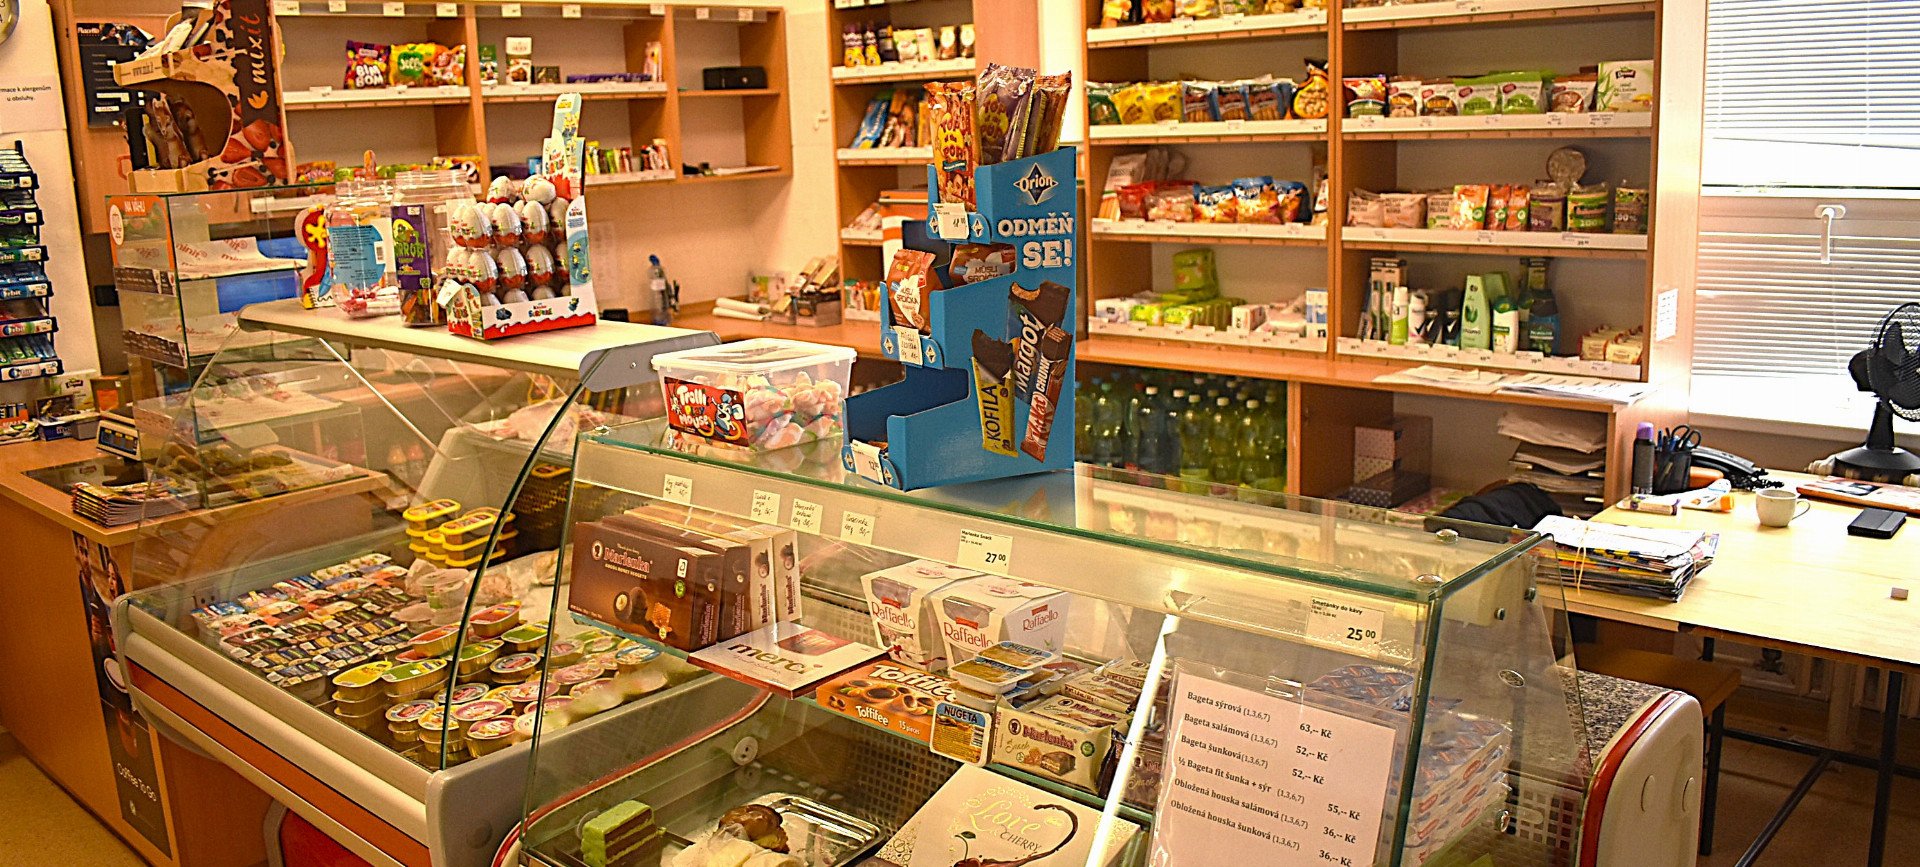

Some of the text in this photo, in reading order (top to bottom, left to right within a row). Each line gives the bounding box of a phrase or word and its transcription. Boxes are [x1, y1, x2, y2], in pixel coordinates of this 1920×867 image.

[240, 13, 267, 84] mixit
[355, 64, 381, 77] BIM
[355, 75, 384, 88] BOM
[1020, 174, 1053, 192] Orion
[997, 211, 1075, 237] ODMĚŇ
[1022, 239, 1073, 269] SE!
[1013, 313, 1046, 393] Margot
[677, 385, 706, 406] Trolli
[981, 385, 1001, 441] KOFILA
[604, 547, 650, 573] Marlenka
[985, 552, 997, 563] 27
[871, 602, 916, 630] Raffaello
[1023, 611, 1059, 631] Raffaello
[1346, 627, 1376, 641] 25 00
[727, 643, 823, 675] merci
[856, 705, 889, 727] Toffifee
[899, 719, 907, 731] 15
[943, 705, 978, 724] NUGETA
[1187, 691, 1214, 705] Bageta
[1214, 699, 1242, 714] sýrová
[1320, 728, 1332, 739] Kč
[1022, 724, 1074, 751] Marlenka
[1184, 713, 1210, 728] Bageta
[1211, 721, 1249, 739] salámová
[1316, 751, 1328, 762] Kč
[1181, 735, 1207, 749] Bageta
[1313, 774, 1325, 785] Kč
[117, 763, 157, 802] Coffee To Go
[1187, 759, 1214, 774] Bageta
[1214, 768, 1224, 778] fit
[1225, 771, 1250, 786] šunka
[1258, 782, 1272, 793] sýr
[1349, 810, 1361, 821] Kč
[969, 800, 1041, 834] Love
[1174, 778, 1210, 796] Obložená
[1211, 789, 1240, 806] houska
[1241, 801, 1279, 819] salámová
[1344, 833, 1356, 844] Kč
[1000, 824, 1042, 854] CHERRY
[1170, 799, 1206, 818] Obložená
[1207, 811, 1236, 829] houska
[1237, 822, 1271, 840] šunková
[1340, 856, 1352, 867] Kč
